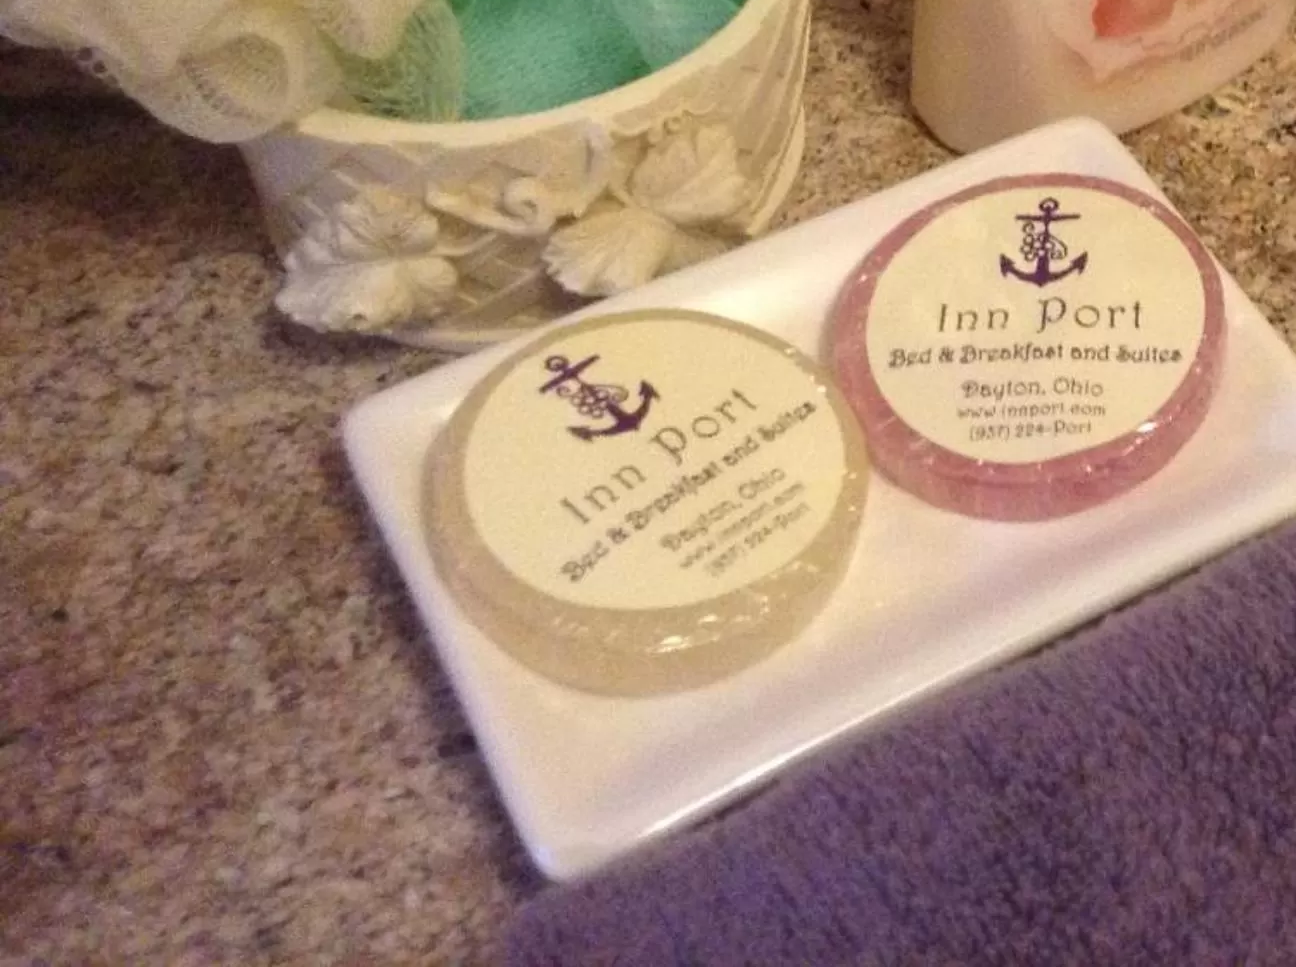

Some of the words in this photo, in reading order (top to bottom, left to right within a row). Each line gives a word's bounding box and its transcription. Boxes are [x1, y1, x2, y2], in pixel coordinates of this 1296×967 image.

[938, 302, 1010, 333] Inn
[1036, 295, 1144, 334] Port
[887, 346, 932, 368] Bed
[938, 347, 954, 363] &
[959, 340, 1064, 365] Breakfast
[1070, 343, 1110, 362] and
[1115, 343, 1183, 364] Suites
[1053, 376, 1104, 397] Ohio
[559, 463, 647, 525] Inn
[649, 388, 758, 467] Port
[722, 435, 761, 467] and
